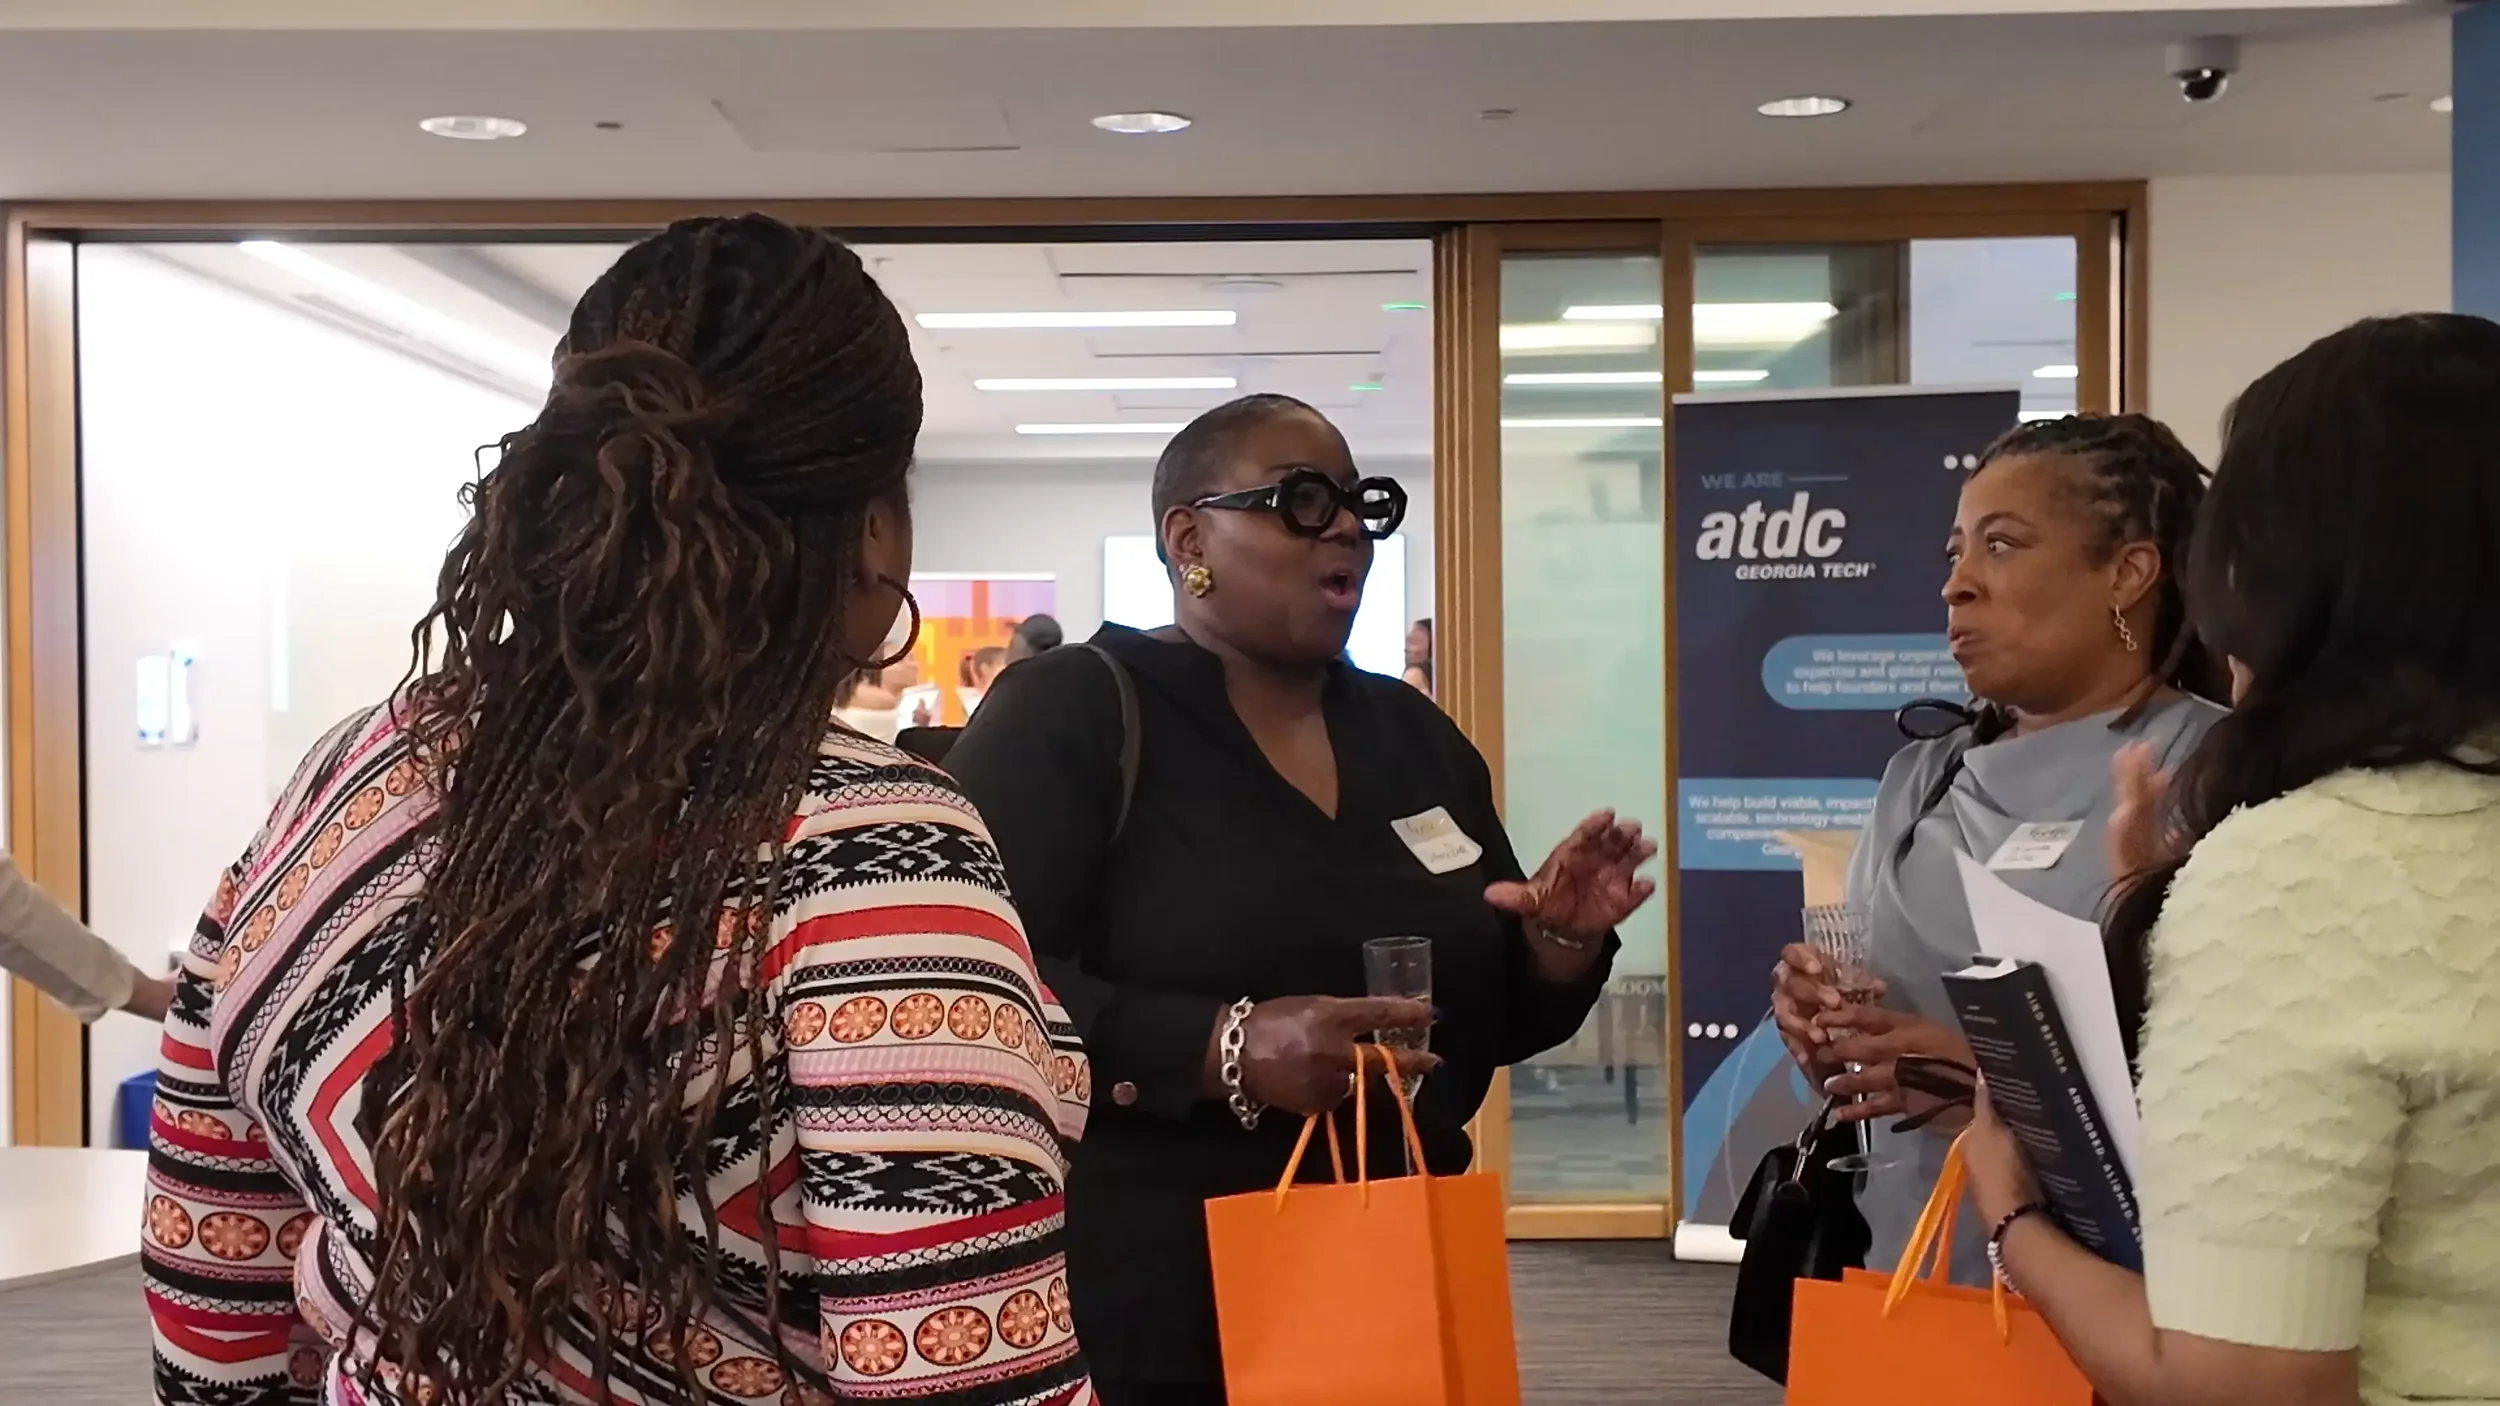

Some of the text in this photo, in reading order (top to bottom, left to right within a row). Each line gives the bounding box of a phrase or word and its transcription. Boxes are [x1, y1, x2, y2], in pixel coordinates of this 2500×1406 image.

[1701, 473, 1783, 489] WE ARE
[1695, 490, 1846, 560] atdc
[1735, 563, 1816, 580] GEORGIA
[1812, 650, 1835, 662] We
[1803, 681, 1833, 696] help
[1688, 796, 1710, 808] We
[1712, 796, 1741, 810] help
[1744, 796, 1776, 808] build
[1761, 843, 1802, 859] Georg
